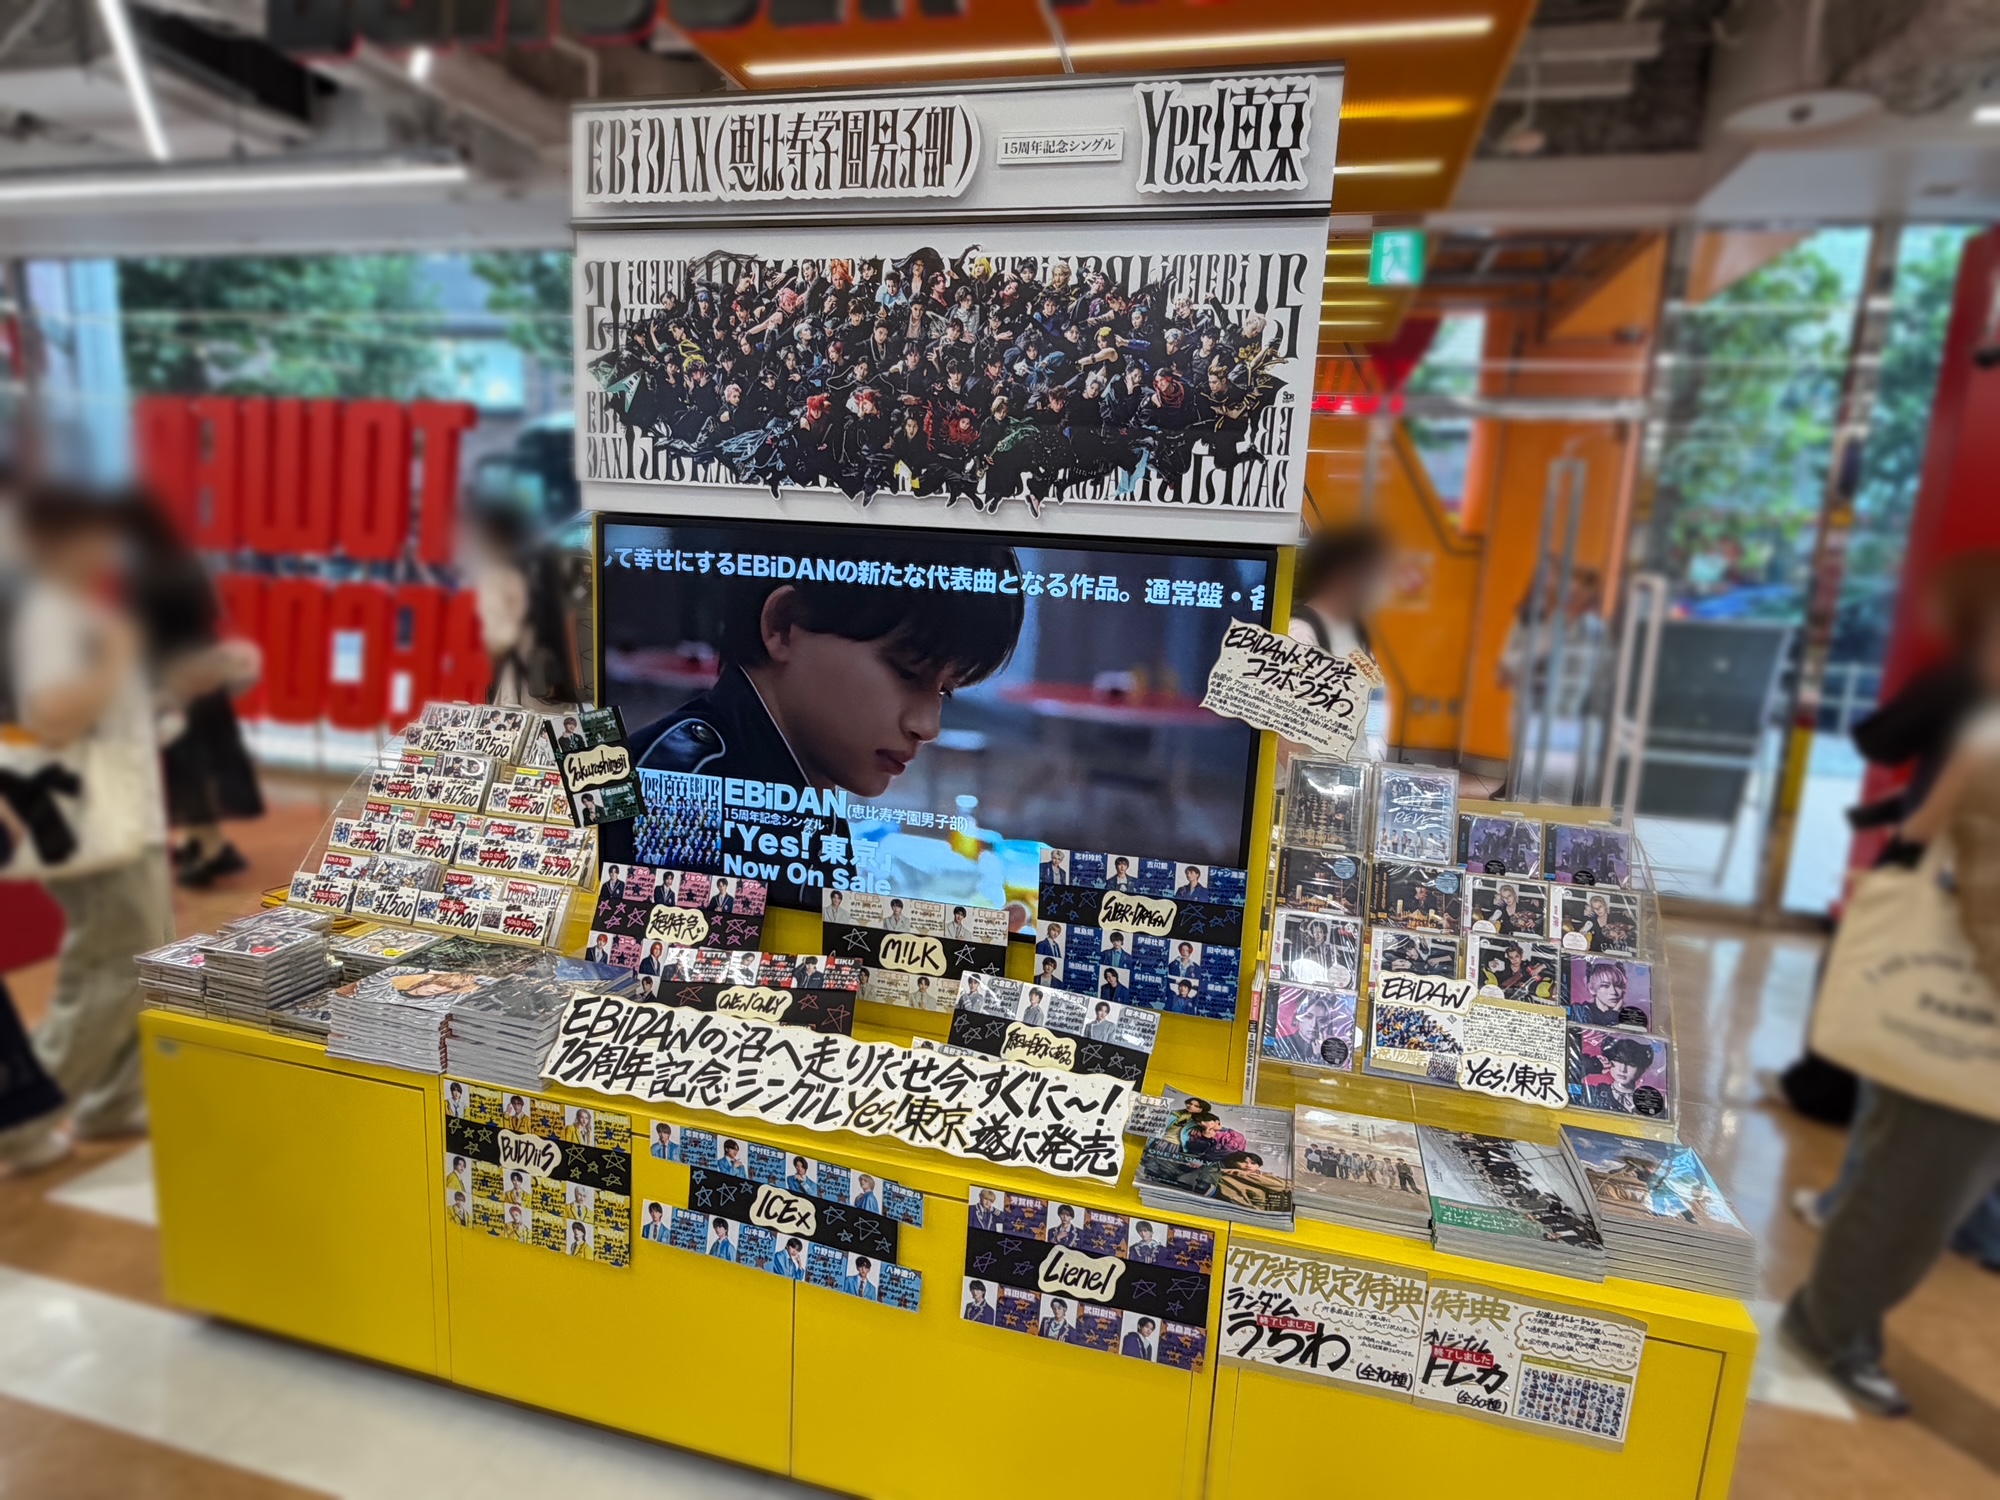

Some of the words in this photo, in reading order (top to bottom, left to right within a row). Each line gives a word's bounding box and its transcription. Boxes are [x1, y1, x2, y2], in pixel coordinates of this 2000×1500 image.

[1002, 137, 1116, 157] 15周年記念シングル
[1242, 657, 1355, 719] コラボうちわ
[474, 736, 510, 759] ¥1,500
[723, 807, 826, 831] 15周年記念シングル
[724, 777, 848, 819] EBiDAN
[847, 803, 969, 833] (恵比寿学園男子部)
[723, 853, 779, 882] Now
[786, 863, 825, 889] On
[832, 869, 893, 896] Sale
[371, 892, 413, 918] ¥1,500
[648, 909, 705, 941] 超特急
[702, 951, 727, 960] TETTA
[772, 954, 787, 962] REI
[834, 958, 855, 967] EIKU
[881, 937, 940, 971] M!LK
[1381, 976, 1472, 1009] EBiDAN
[1466, 1057, 1565, 1102] Yes!東京
[500, 1135, 555, 1172] BUDDiiS
[1148, 1148, 1170, 1158] ONE
[1185, 1156, 1213, 1168] ONLY
[1043, 1250, 1117, 1296] Lienel
[1227, 1247, 1425, 1321] タワ渋限定特典
[1226, 1286, 1300, 1317] ランダム
[1431, 1288, 1512, 1332] 特典
[1258, 1315, 1313, 1331] 終了しました
[1226, 1311, 1351, 1373] うちわ
[1432, 1347, 1492, 1366] 終了しました
[1355, 1362, 1414, 1392] (全10種)
[1421, 1356, 1509, 1395] トレカ
[1456, 1389, 1508, 1415] (全60種)
